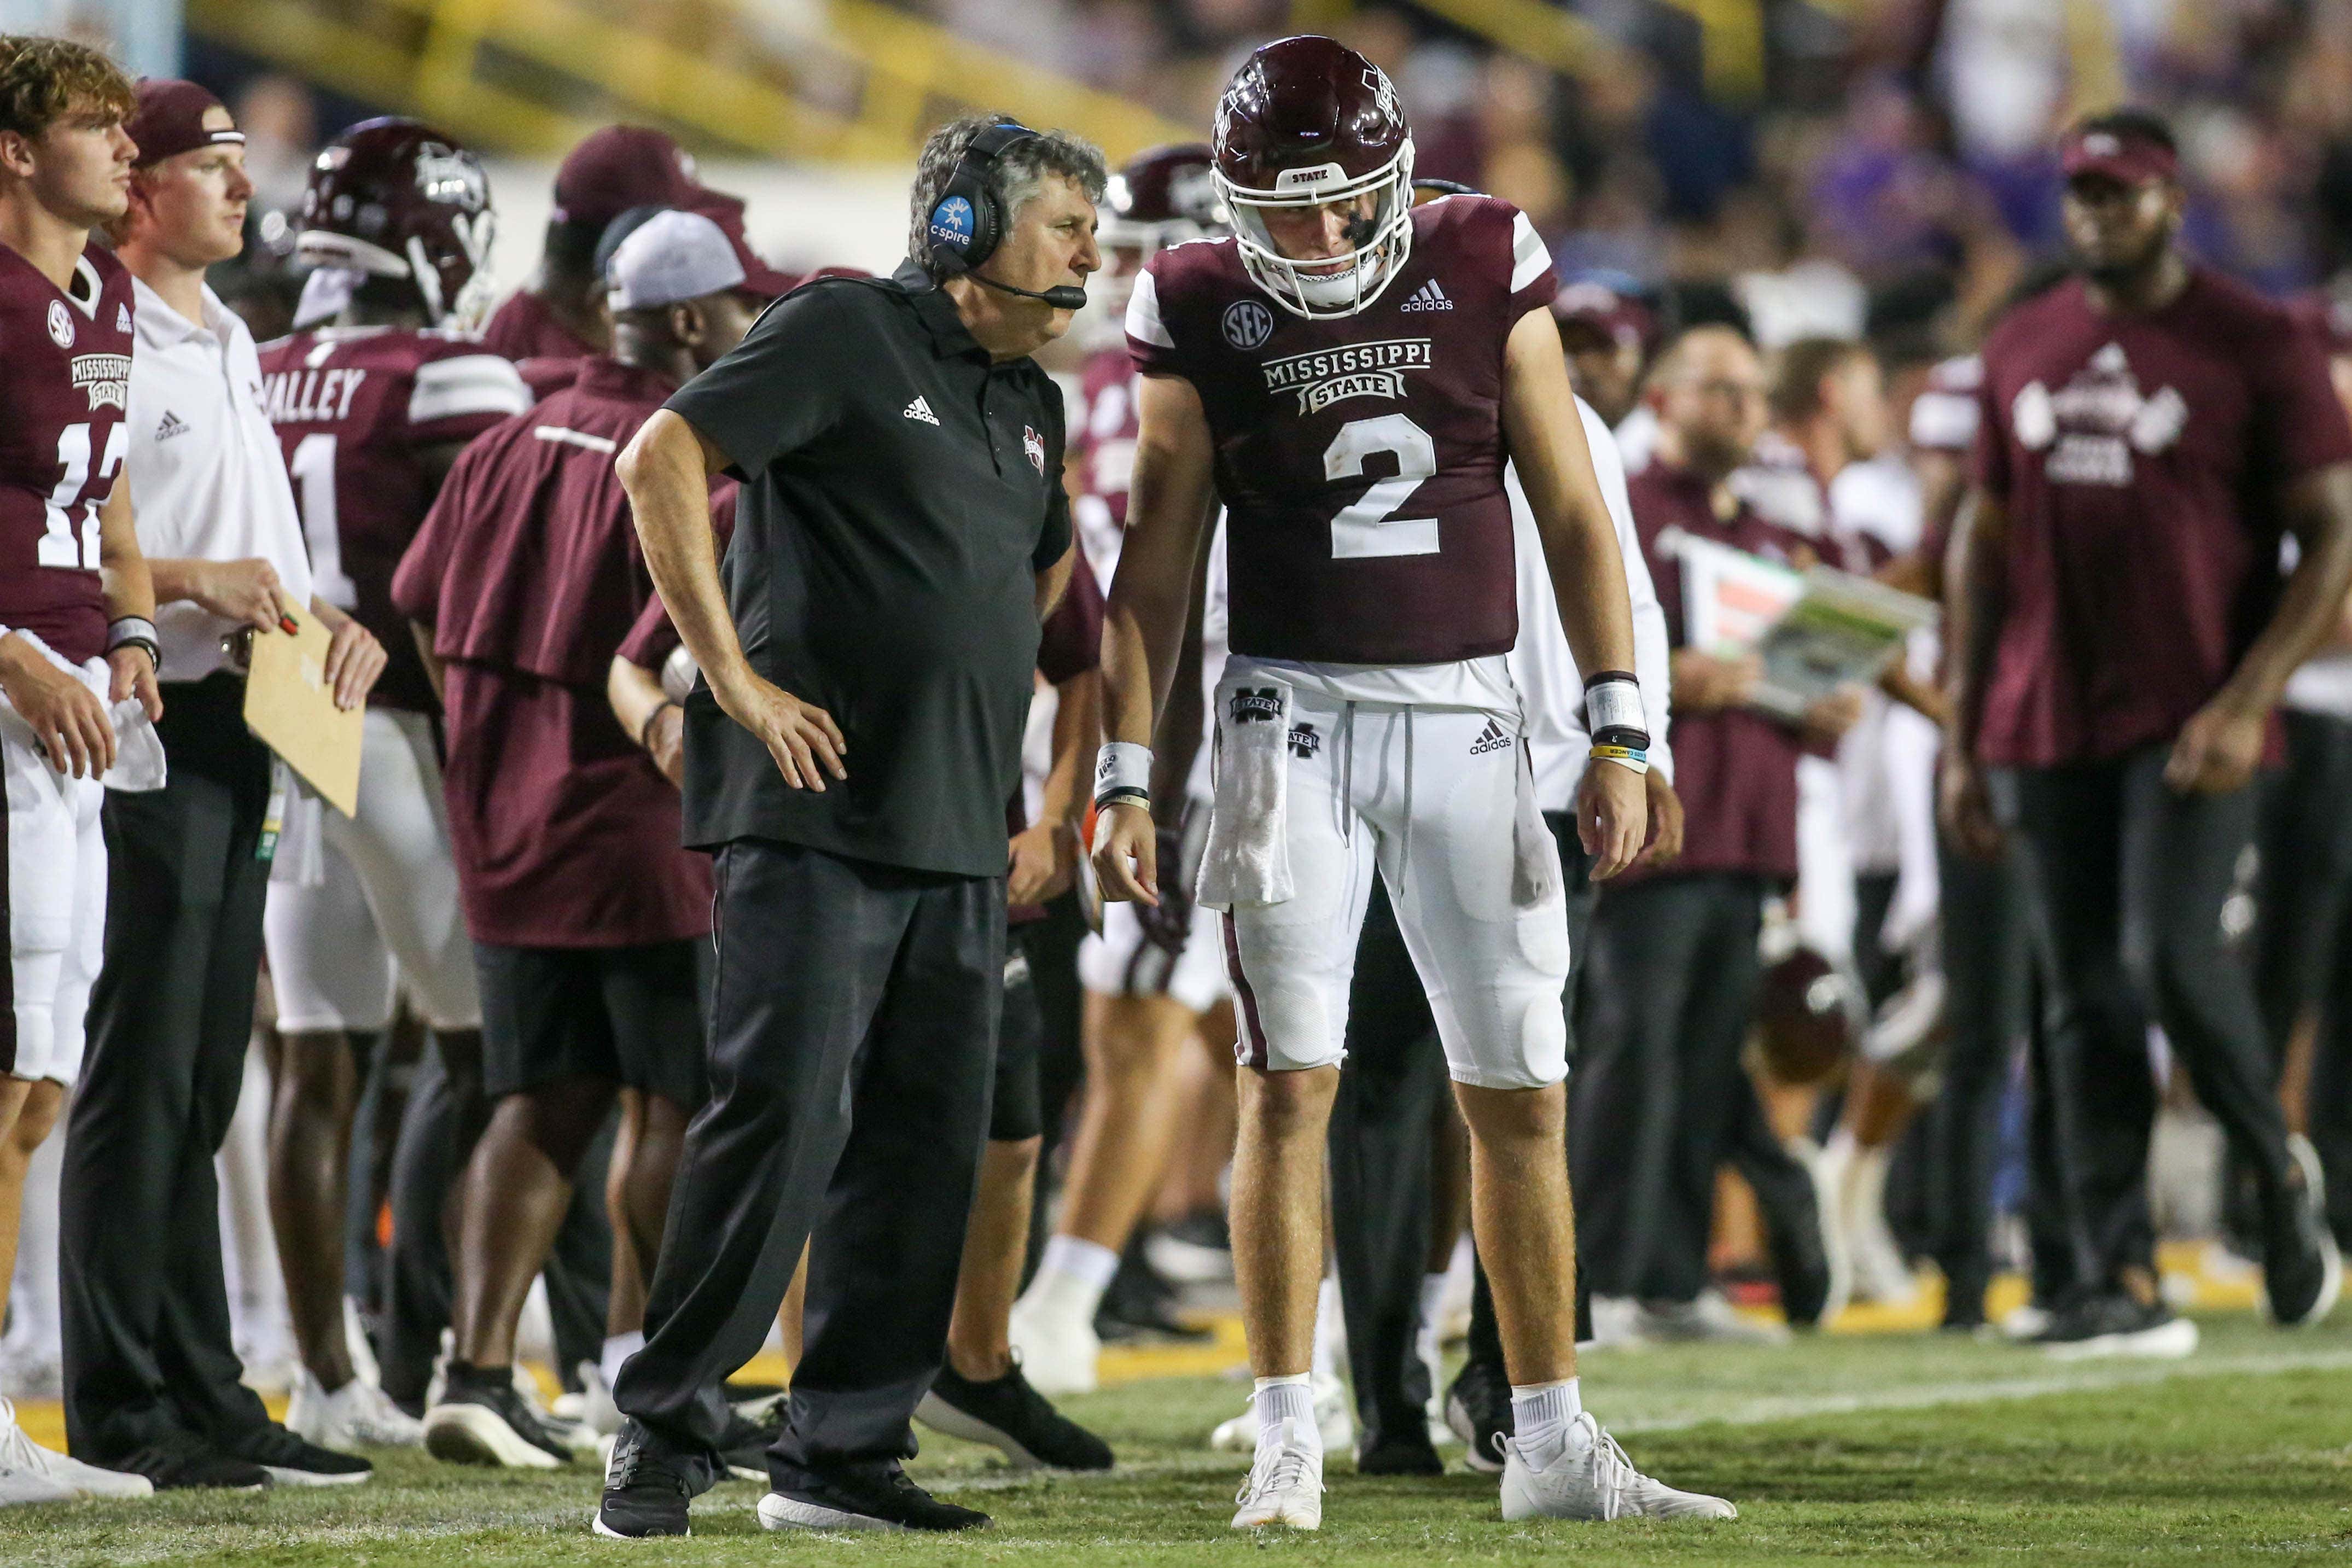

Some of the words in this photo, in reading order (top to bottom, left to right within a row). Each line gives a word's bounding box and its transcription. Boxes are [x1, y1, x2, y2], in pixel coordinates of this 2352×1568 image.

[1292, 169, 1328, 183] STATE
[939, 228, 970, 245] spire
[1400, 298, 1453, 312] adidas
[1226, 305, 1268, 346] SEC
[1264, 344, 1431, 388] MISSISSIPPI
[95, 384, 121, 403] STATE
[1315, 377, 1387, 405] STATE
[903, 409, 940, 426] adidas
[1323, 413, 1440, 559] 2
[290, 433, 359, 610] 1
[1288, 733, 1309, 744] ATE
[1470, 737, 1511, 755] adidas
